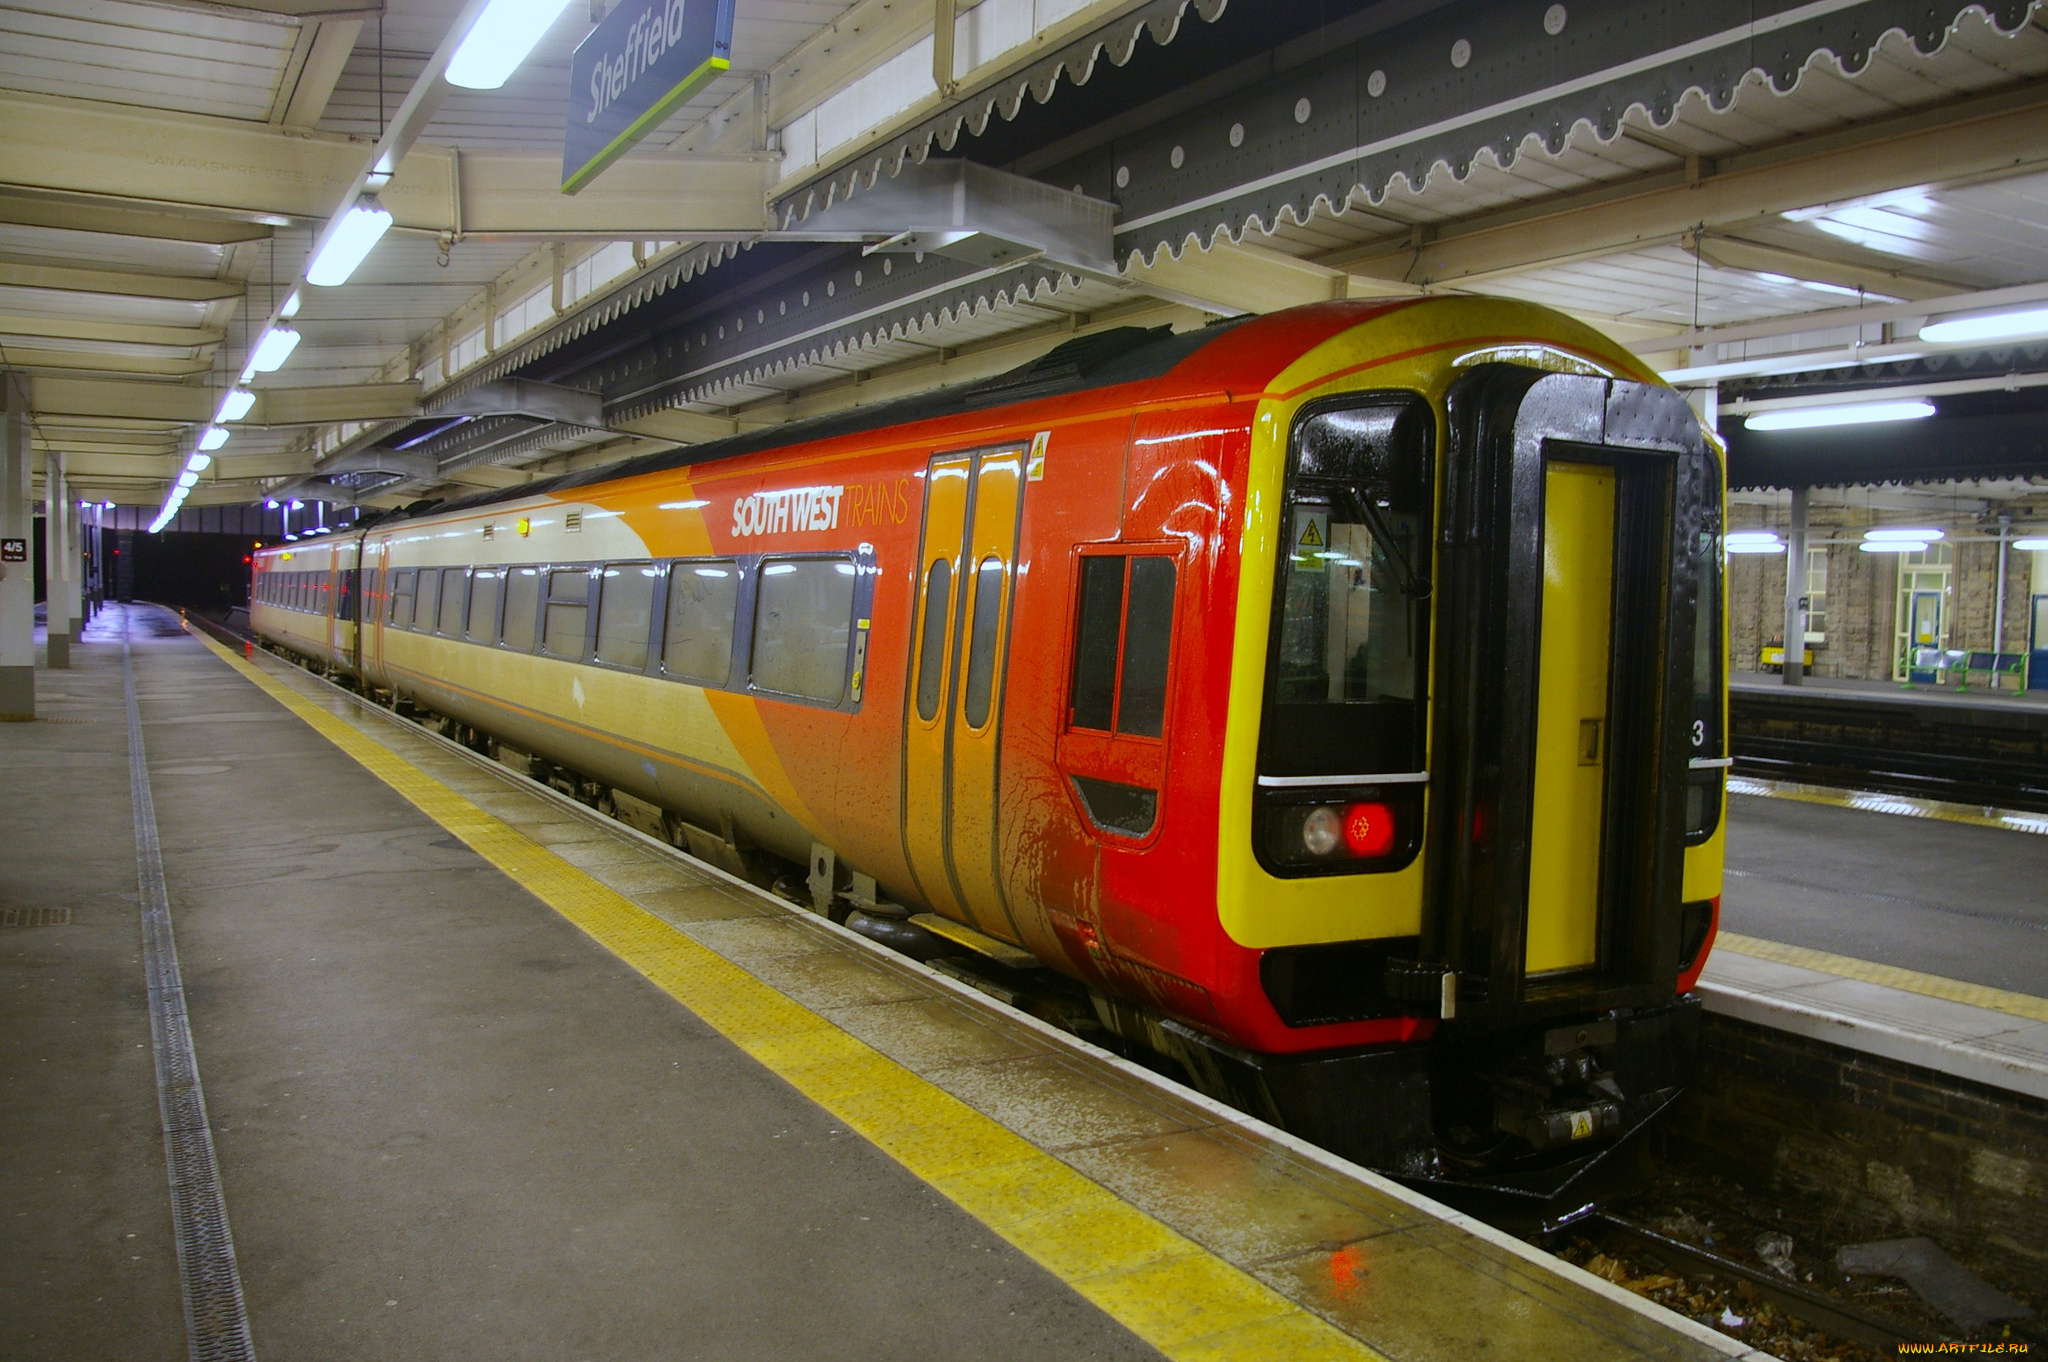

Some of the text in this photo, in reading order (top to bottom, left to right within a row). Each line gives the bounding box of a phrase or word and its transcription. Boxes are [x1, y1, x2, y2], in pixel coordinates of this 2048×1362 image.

[587, 0, 684, 123] Sheffield
[145, 153, 257, 178] LANARKSHIRE
[731, 478, 909, 537] SOUTH WEST TRAINS
[3, 541, 24, 553] 4/5
[1692, 719, 1704, 746] 3
